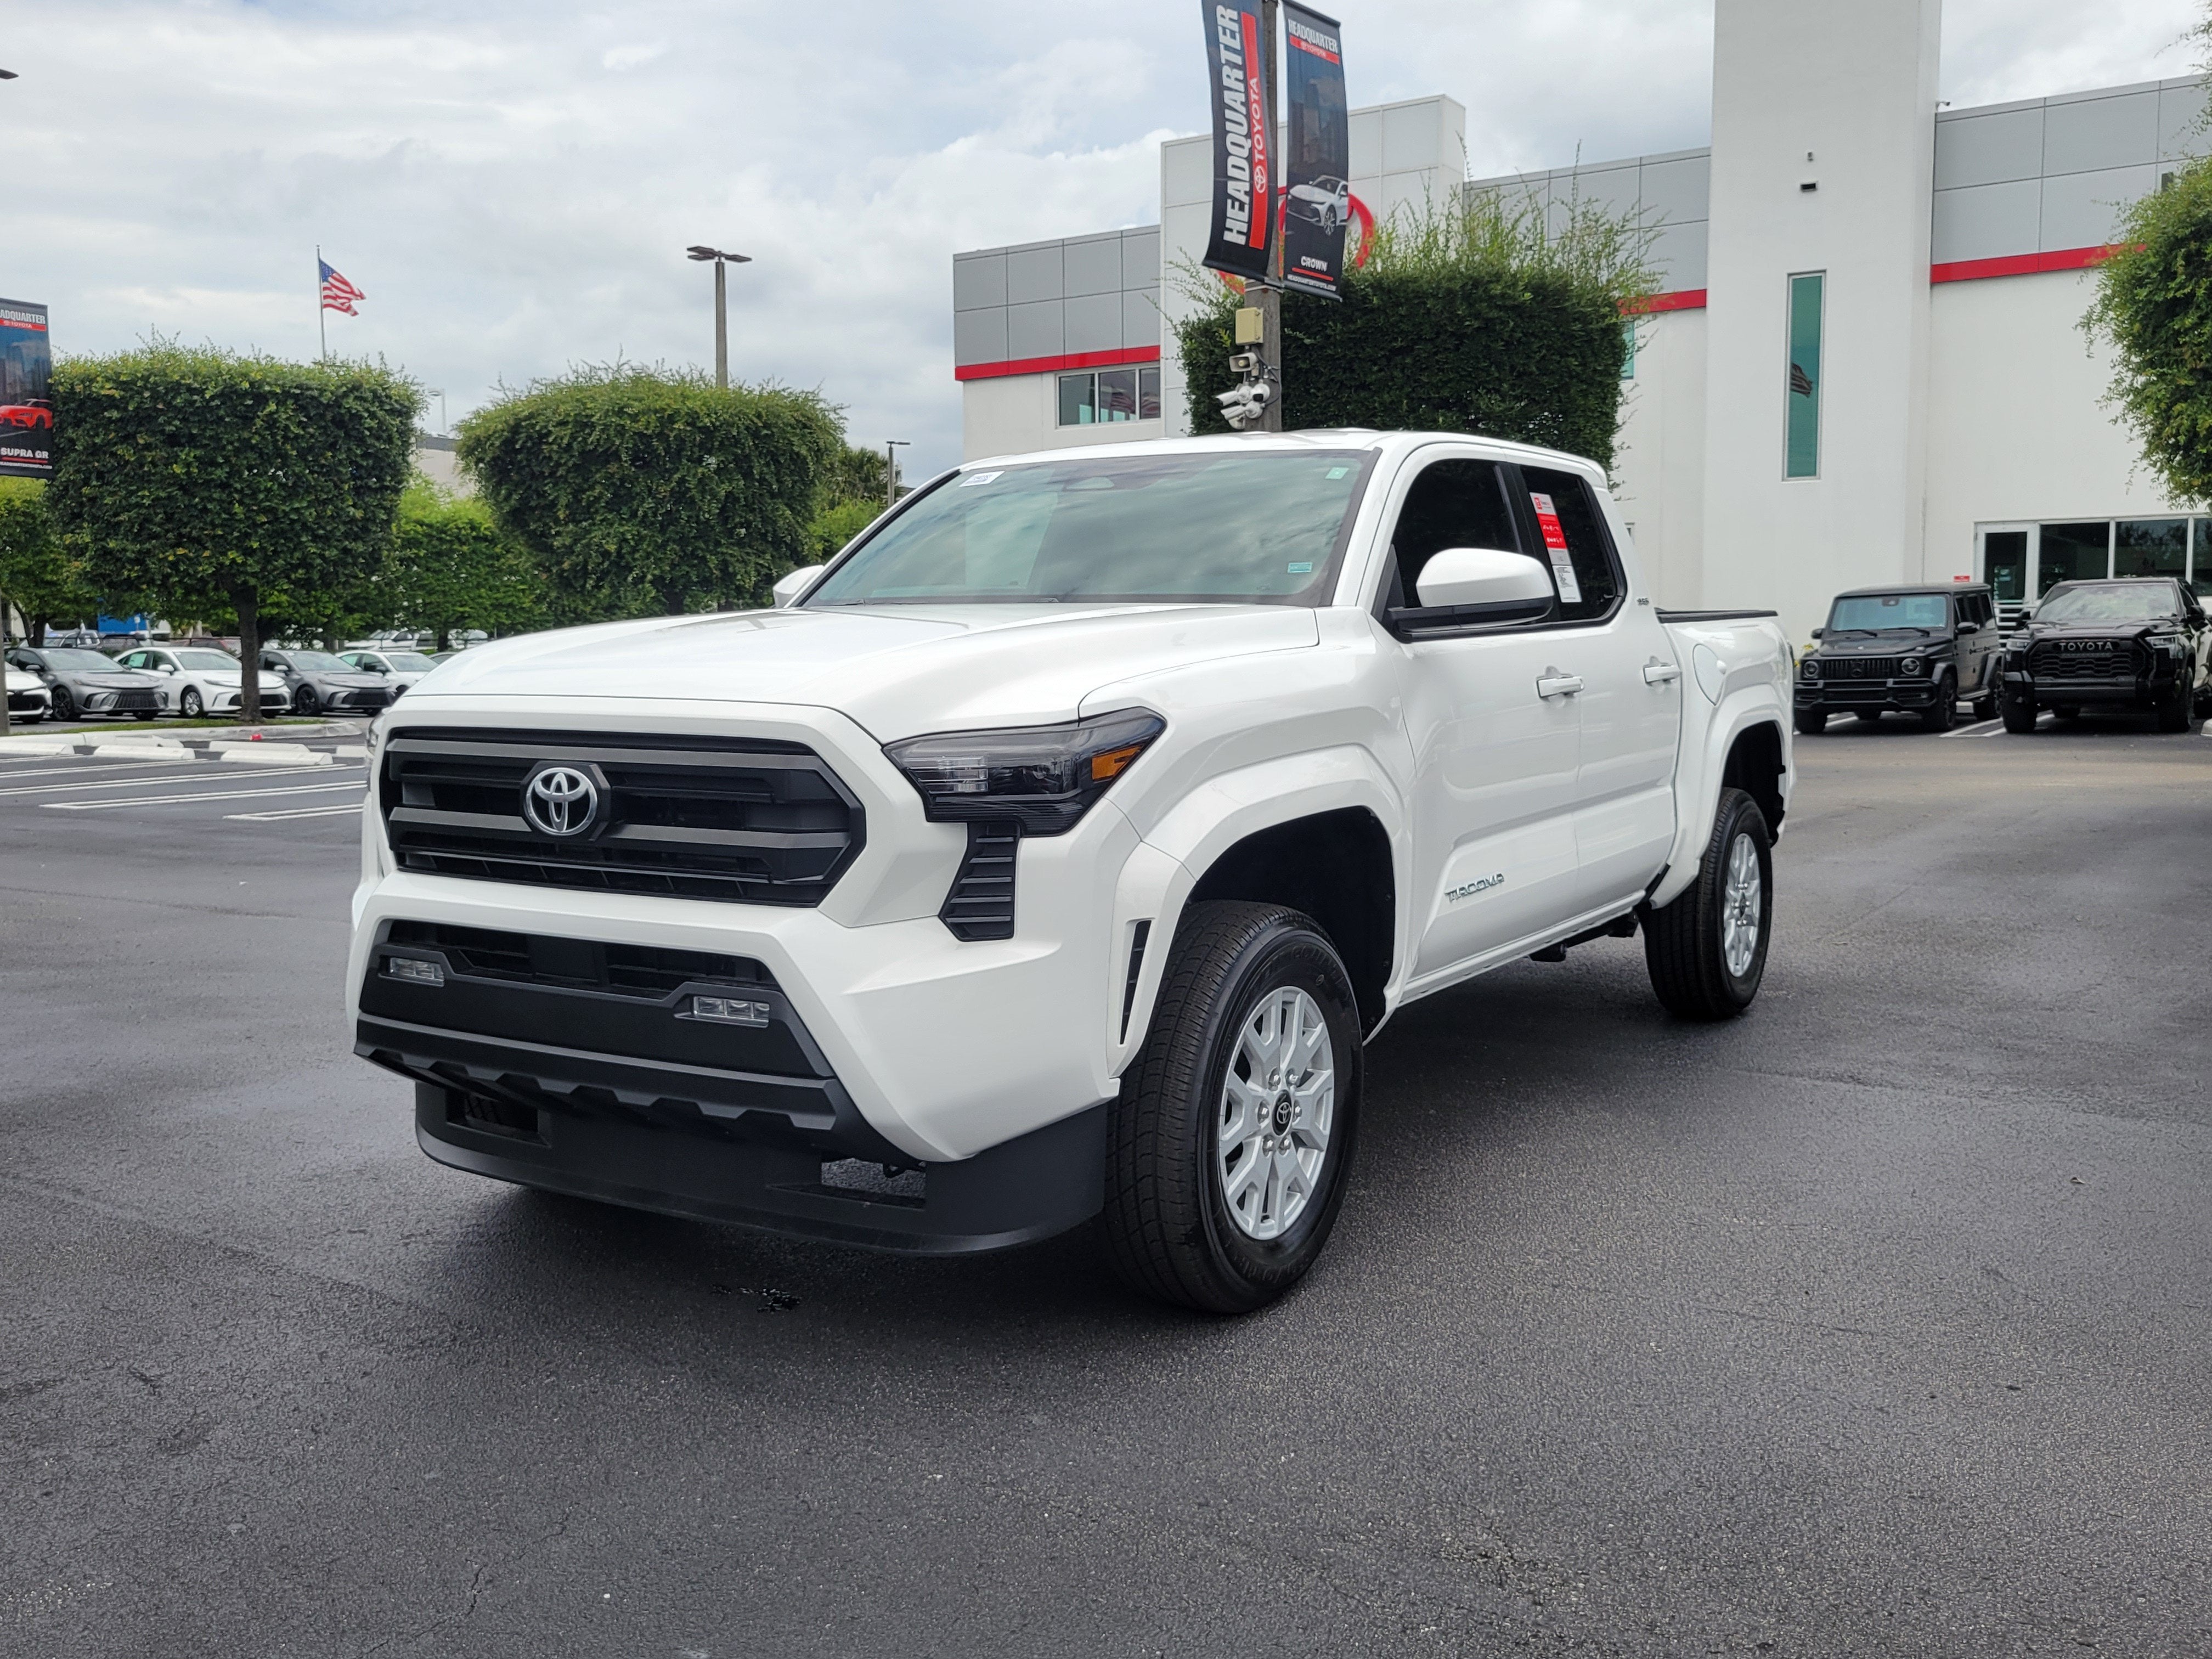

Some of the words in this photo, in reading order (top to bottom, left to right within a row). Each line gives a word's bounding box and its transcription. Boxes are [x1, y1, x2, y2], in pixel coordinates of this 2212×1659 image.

[1288, 18, 1338, 54] HEADQUARTER
[1216, 4, 1251, 245] HEADQUARTER
[1249, 77, 1264, 162] TOYOTA
[1301, 256, 1328, 272] CROWN
[0, 309, 46, 324] ADQUARTER
[1, 447, 33, 458] SUPRA
[35, 450, 49, 459] GR
[2059, 642, 2113, 651] TOYOTA
[1444, 873, 1504, 903] TACOMA
